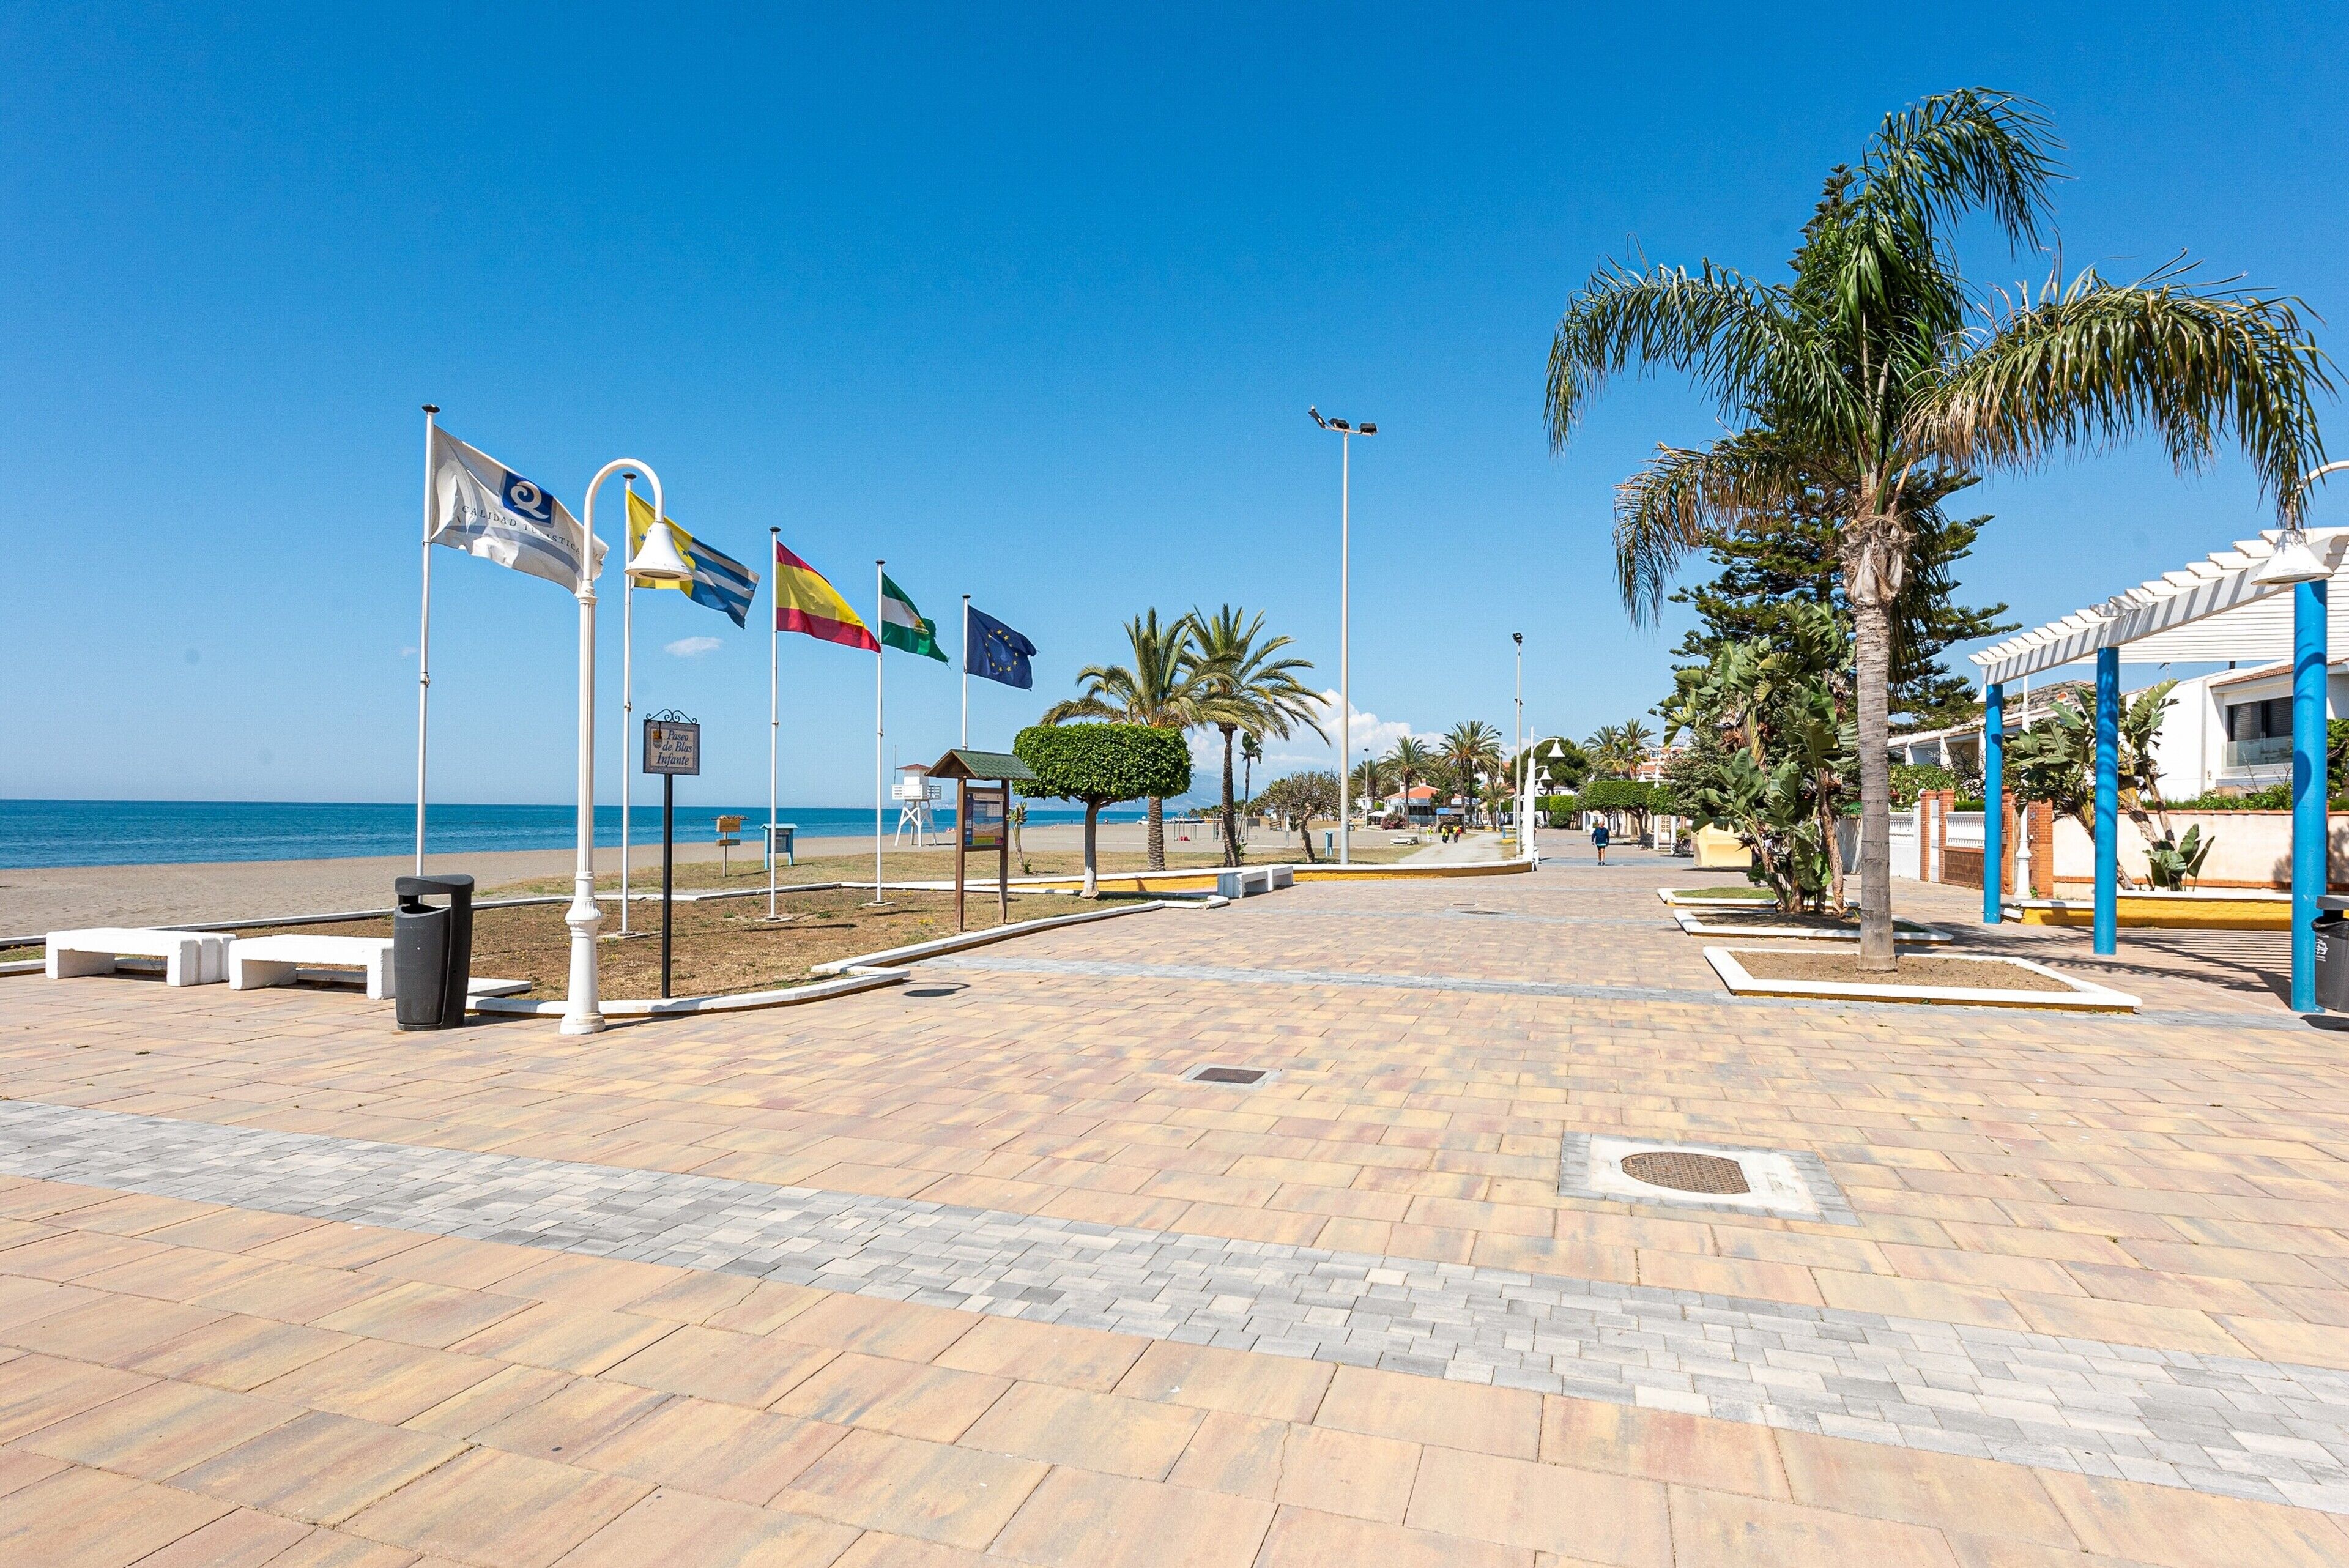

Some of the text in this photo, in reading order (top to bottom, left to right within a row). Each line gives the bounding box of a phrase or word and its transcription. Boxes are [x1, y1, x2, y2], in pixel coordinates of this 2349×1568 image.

[462, 505, 581, 555] CALIDAD TUSTICA
[667, 730, 689, 741] Paseo
[662, 741, 693, 752] de Blas
[657, 752, 689, 767] Infante
